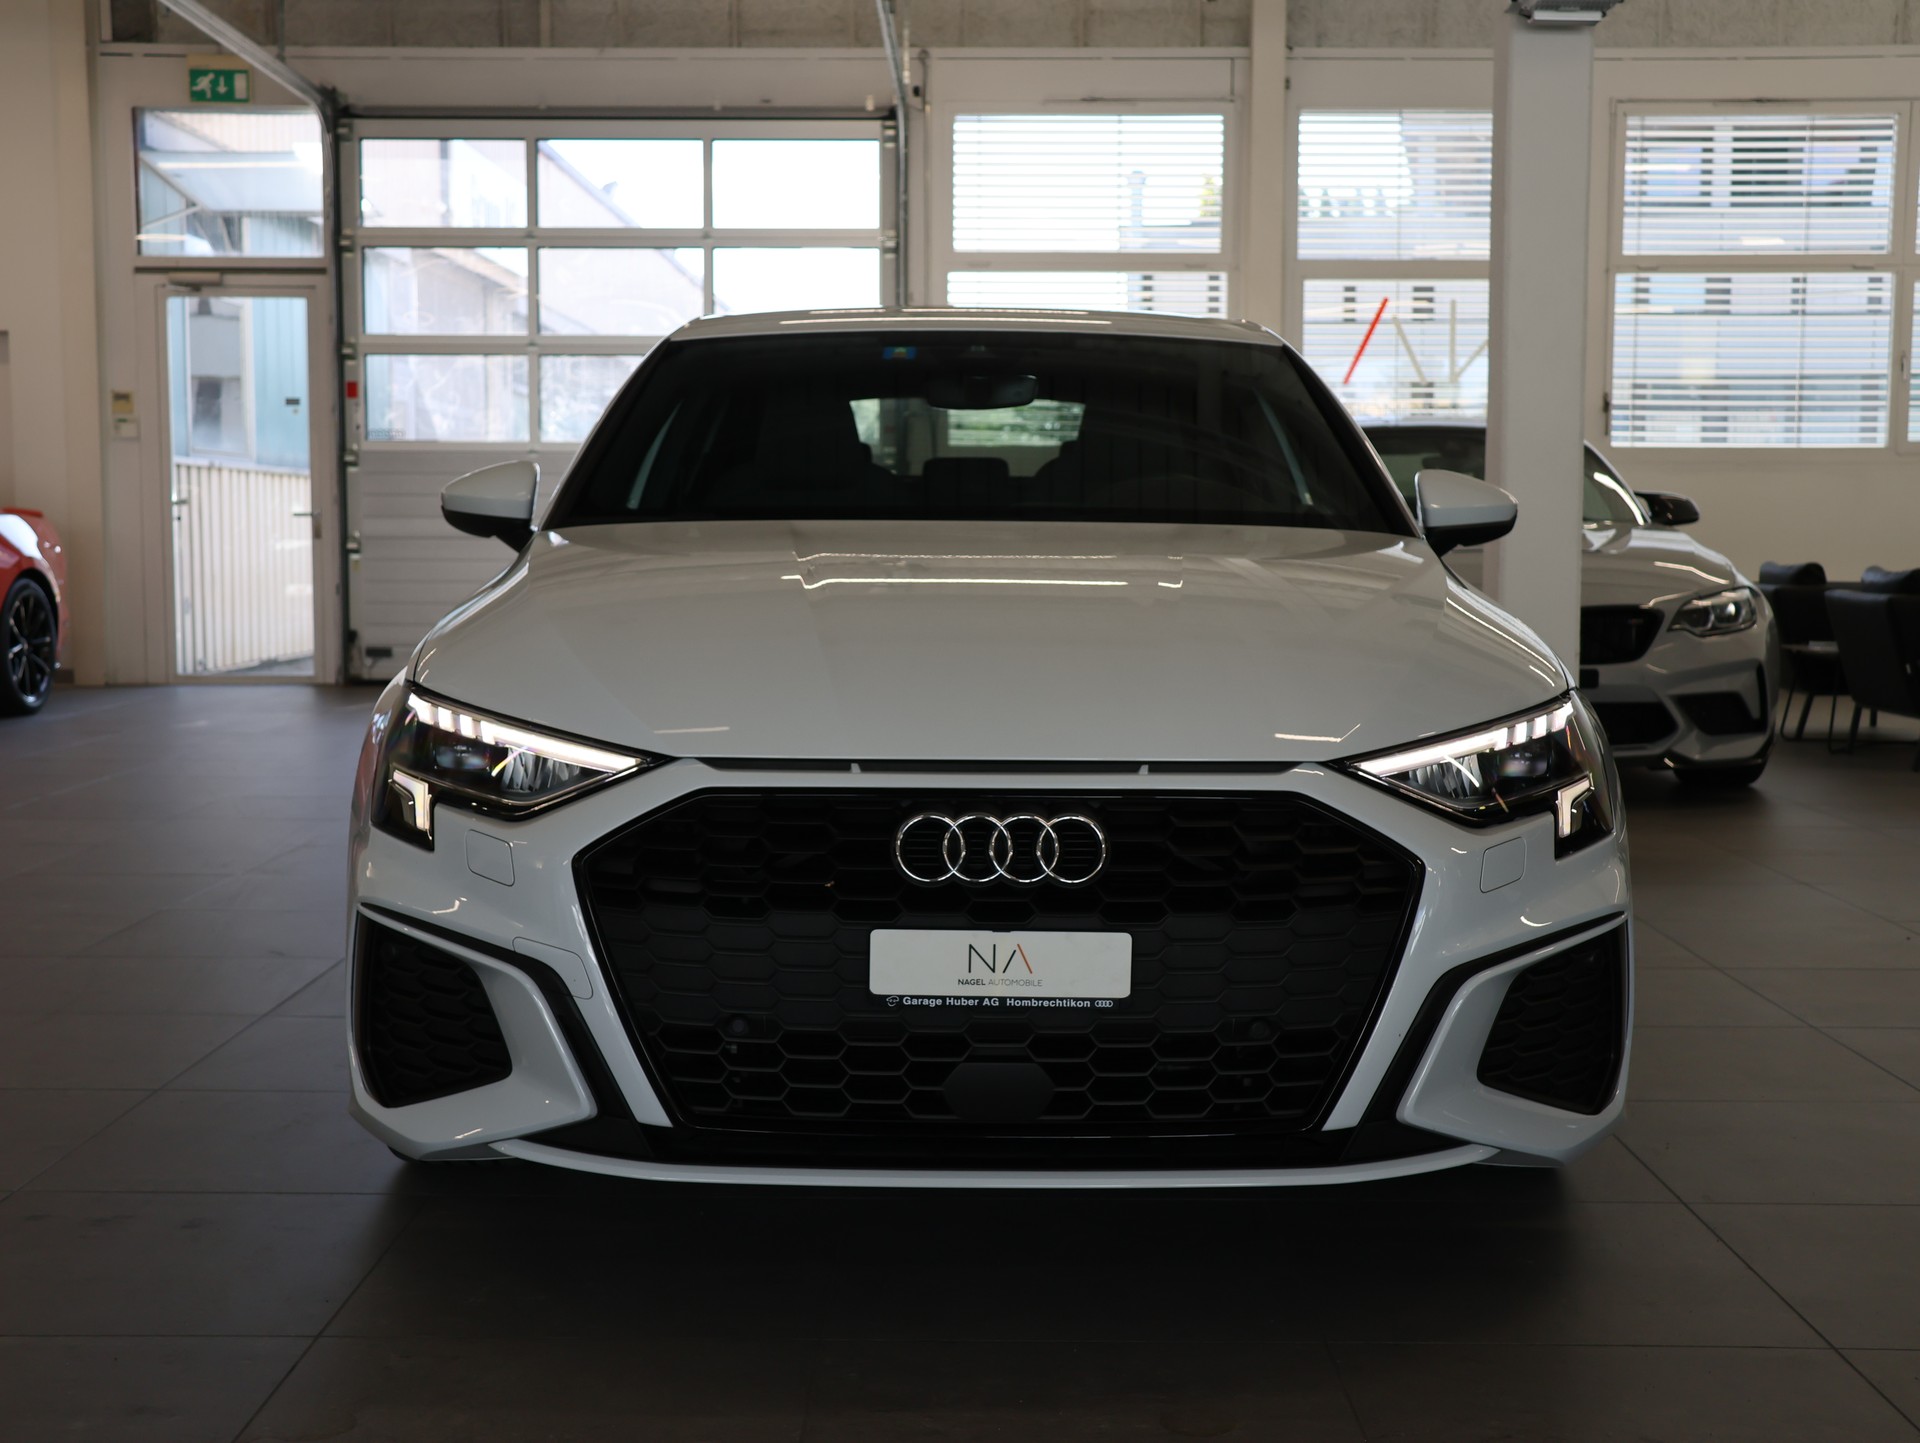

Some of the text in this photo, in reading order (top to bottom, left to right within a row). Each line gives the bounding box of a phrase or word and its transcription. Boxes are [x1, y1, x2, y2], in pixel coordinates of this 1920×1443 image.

[957, 978, 1043, 987] NAGEL AUTOMOBILE
[902, 996, 1091, 1008] Garage Huber AG Hombrechtikon
